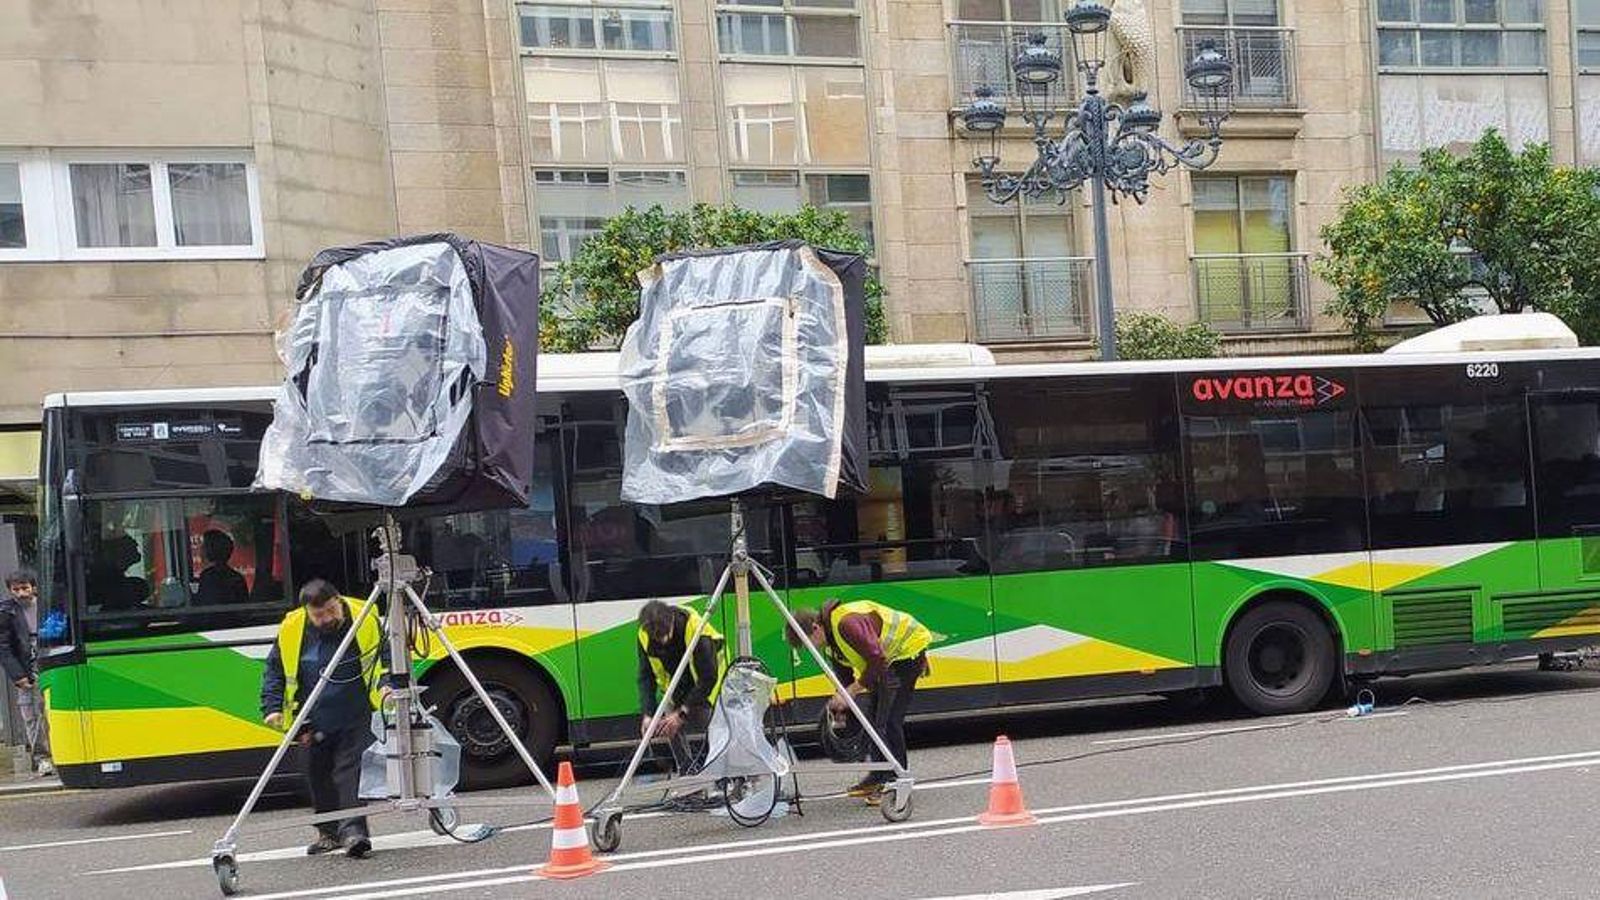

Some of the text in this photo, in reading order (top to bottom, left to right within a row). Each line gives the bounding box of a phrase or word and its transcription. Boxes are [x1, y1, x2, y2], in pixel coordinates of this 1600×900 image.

[1466, 363, 1499, 378] 6220
[1193, 375, 1315, 400] avanza
[439, 610, 502, 626] anza
